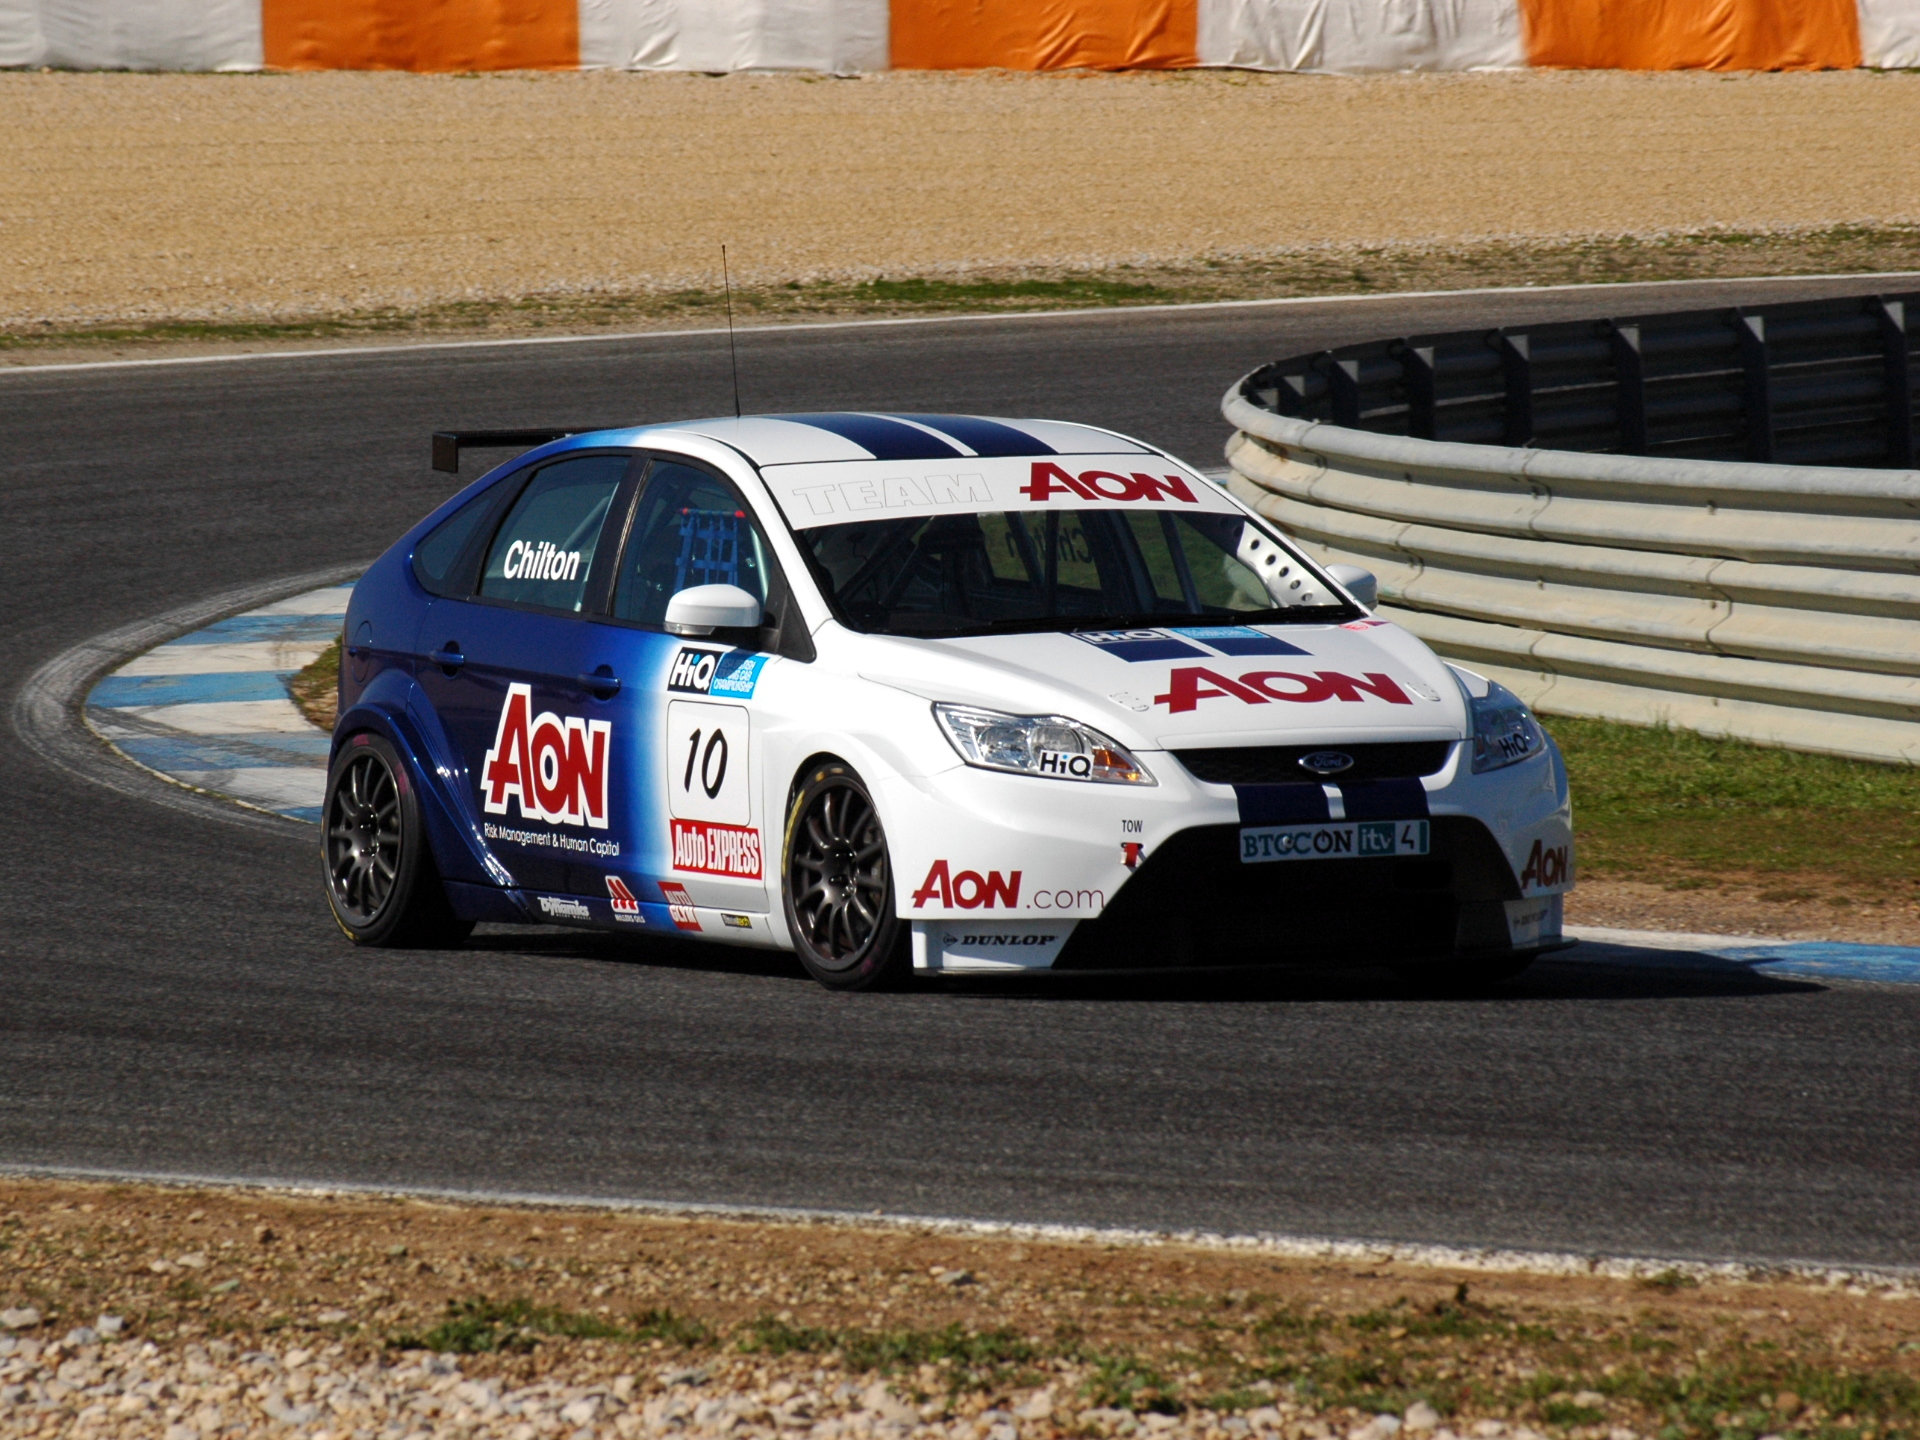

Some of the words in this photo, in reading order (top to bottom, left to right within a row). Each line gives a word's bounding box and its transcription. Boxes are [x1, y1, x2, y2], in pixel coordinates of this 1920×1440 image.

[792, 473, 993, 515] TEAM
[1019, 462, 1200, 503] AON
[503, 539, 580, 580] Chilton
[670, 652, 715, 691] HiQ
[1154, 667, 1413, 714] AON
[481, 683, 611, 829] AON
[1313, 753, 1343, 768] Ford
[1498, 733, 1528, 758] HiQ
[684, 728, 728, 799] 10
[1040, 752, 1091, 778] HiQ
[484, 822, 498, 838] Risk
[499, 826, 551, 846] Management
[552, 833, 559, 848] &
[560, 834, 589, 852] Human
[589, 838, 620, 858] Capital
[1122, 819, 1143, 833] TOW
[1361, 827, 1393, 851] itv
[1401, 824, 1414, 849] 4
[674, 824, 706, 868] Auto
[706, 827, 760, 875] EXPRESS
[540, 898, 590, 916] Dynamics
[664, 890, 693, 905] AUTO
[961, 935, 1056, 946] DUNLOP
